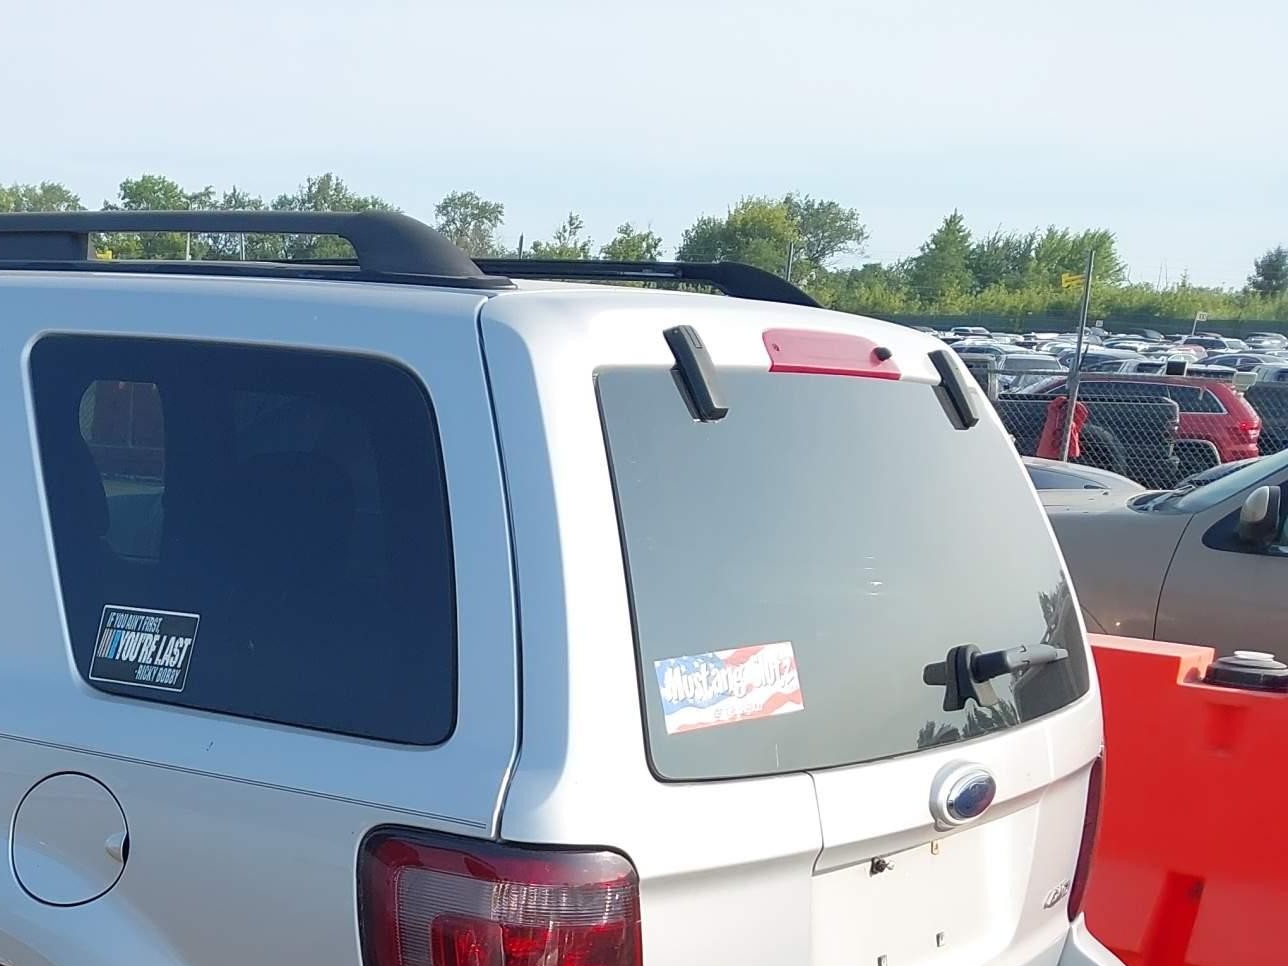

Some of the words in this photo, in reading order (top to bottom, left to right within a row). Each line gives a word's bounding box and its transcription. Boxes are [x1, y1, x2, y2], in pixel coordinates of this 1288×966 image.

[114, 613, 129, 629] YOU
[115, 630, 160, 665] YOU'RE
[154, 635, 192, 668] LAST
[155, 667, 182, 686] BOBBY
[663, 661, 748, 702] Mustang
